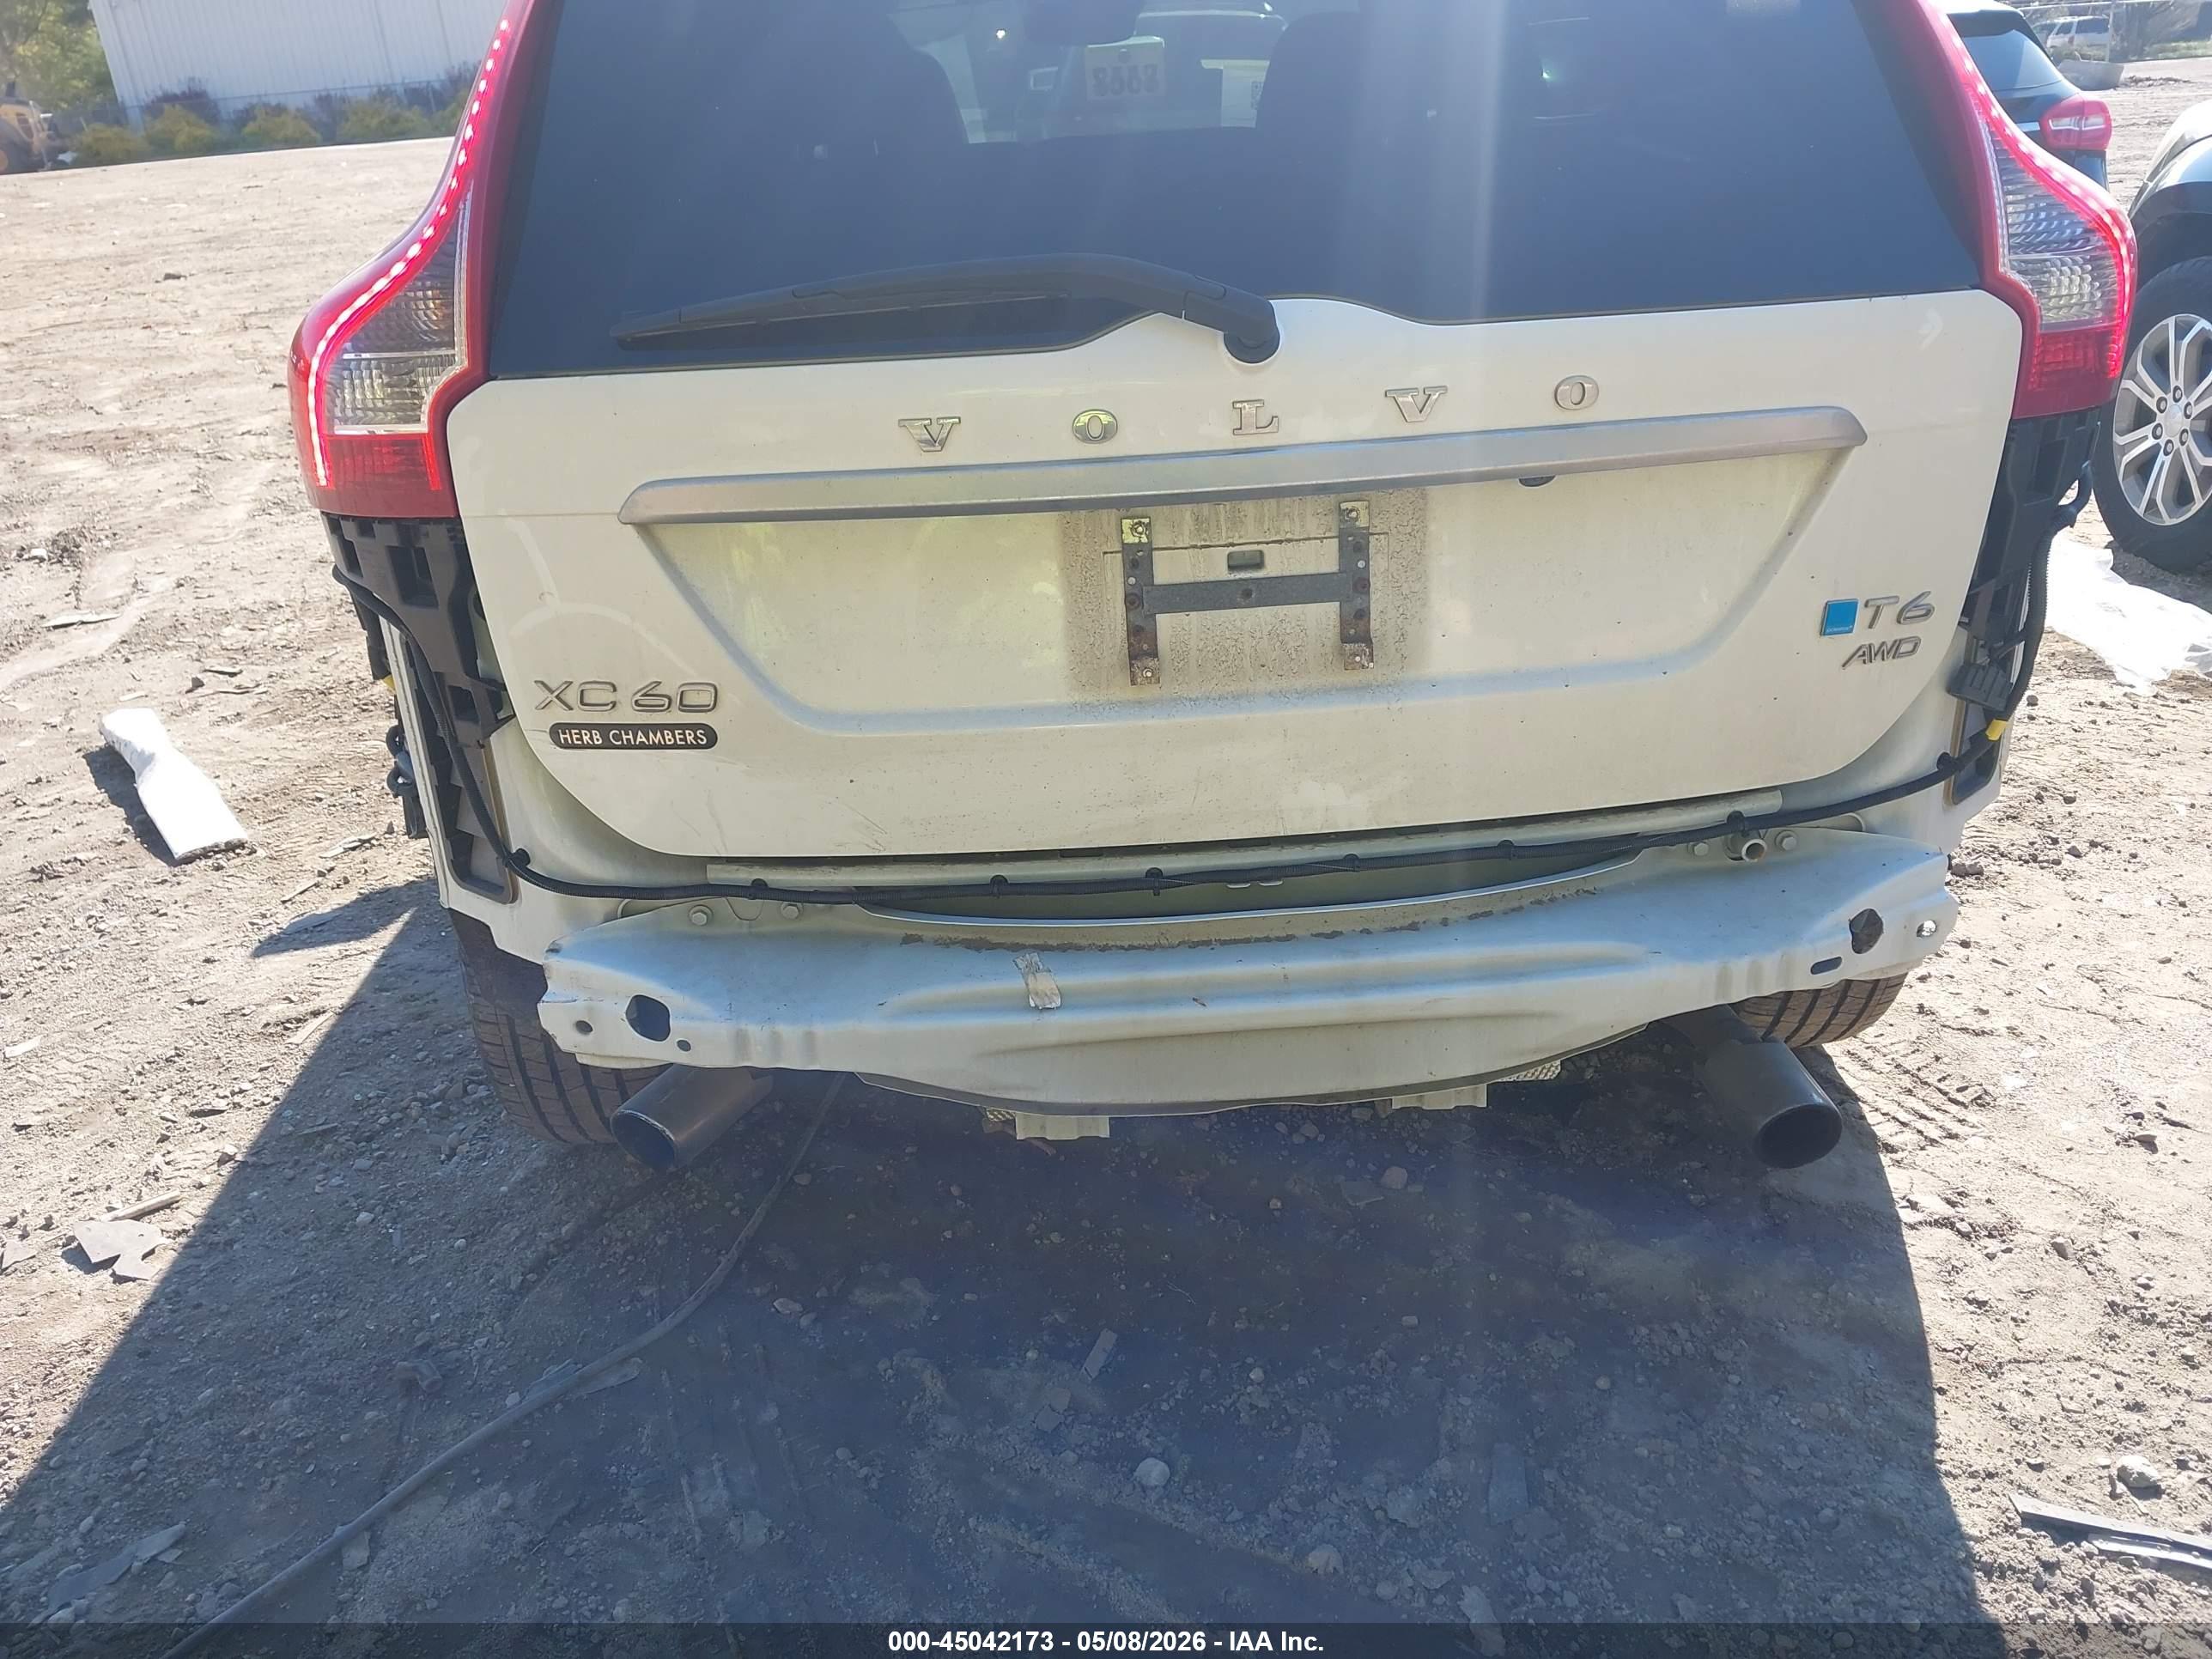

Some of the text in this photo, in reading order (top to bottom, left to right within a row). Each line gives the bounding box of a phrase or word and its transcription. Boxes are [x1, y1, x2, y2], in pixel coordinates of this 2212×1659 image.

[897, 374, 1599, 453] VOLVO
[1864, 590, 1936, 629] T6
[1841, 635, 1922, 670] AWD
[558, 729, 708, 746] HERB CHAMBERS
